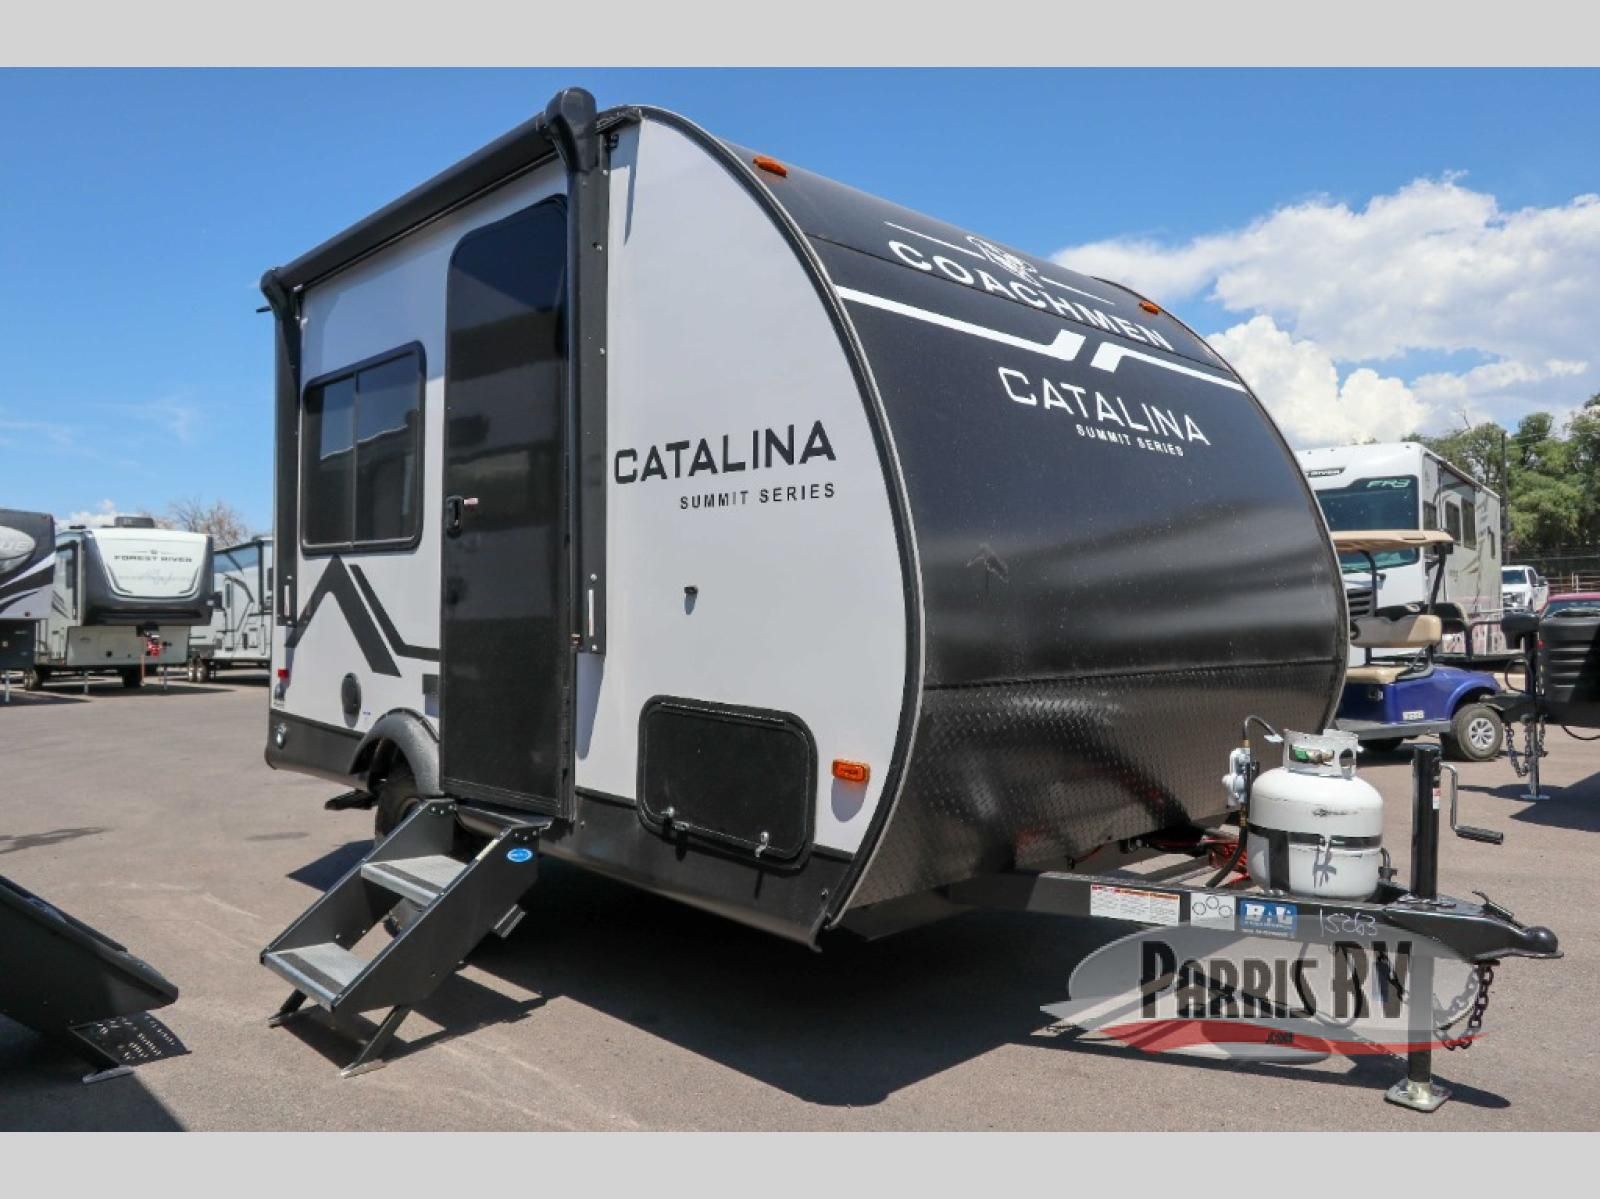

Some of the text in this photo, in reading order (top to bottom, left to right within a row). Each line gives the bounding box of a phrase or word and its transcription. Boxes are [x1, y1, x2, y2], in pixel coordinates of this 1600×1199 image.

[888, 239, 1175, 351] COACHMEN
[998, 366, 1212, 446] CATALINA
[614, 420, 837, 484] CATALINA
[1076, 423, 1184, 457] SUMMIT SERIES
[680, 483, 836, 510] SUMMIT SERIES
[113, 554, 193, 563] FOREST RIVER
